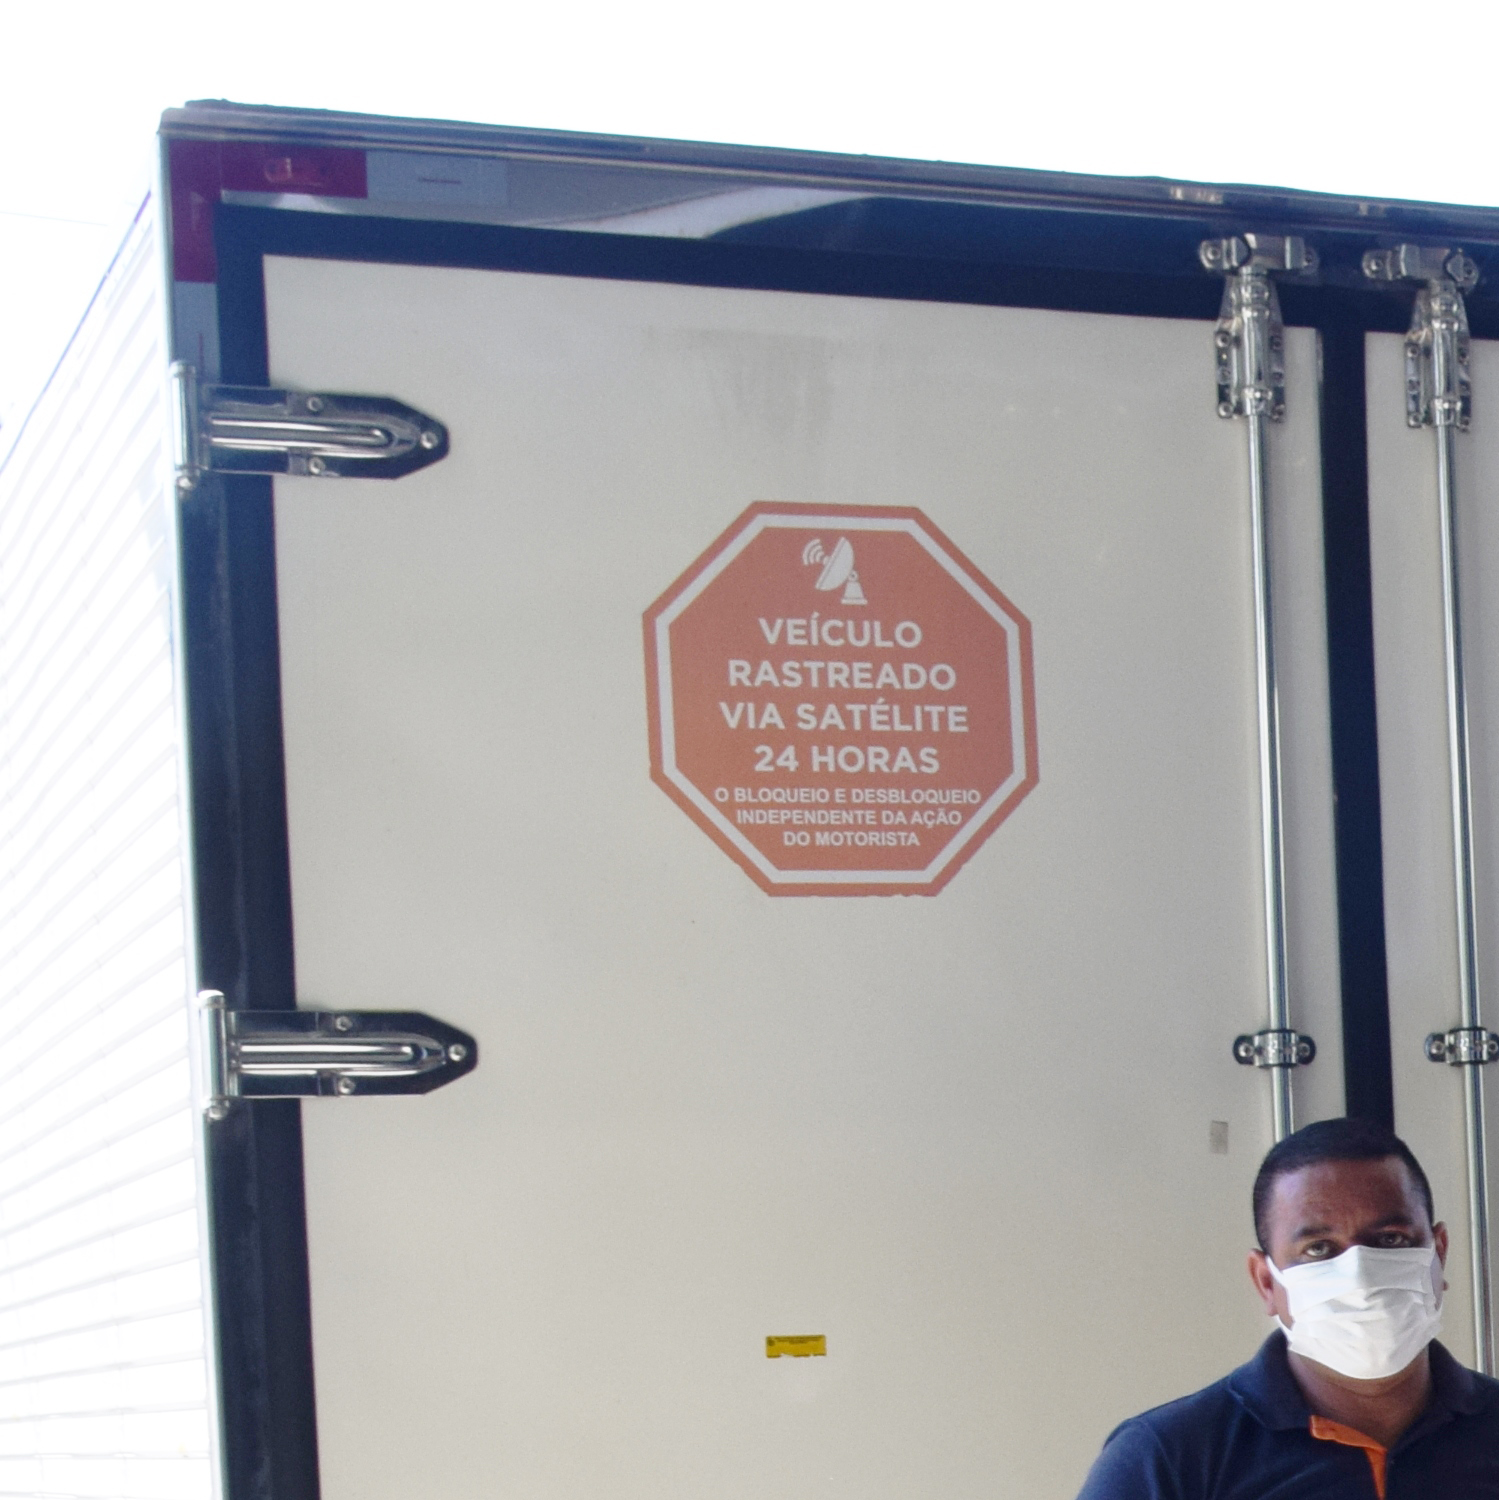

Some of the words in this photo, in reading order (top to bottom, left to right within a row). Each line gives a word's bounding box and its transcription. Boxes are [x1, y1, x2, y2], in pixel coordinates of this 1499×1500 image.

[759, 612, 923, 648] VEÍCULO
[728, 659, 957, 690] RASTREADO
[719, 702, 785, 730] VIA
[797, 697, 969, 732] SATÉLITE
[754, 745, 799, 772] 24
[812, 745, 940, 774] HORAS
[715, 787, 730, 803] O
[734, 787, 830, 805] BLOQUEIO
[835, 788, 846, 803] E
[852, 788, 981, 805] DESBLOQUEIO
[736, 809, 877, 826] INDEPENDENTE
[882, 810, 907, 826] DA
[911, 806, 962, 829] AÇÃO
[783, 831, 810, 846] DO
[815, 831, 920, 847] MOTORISTA
